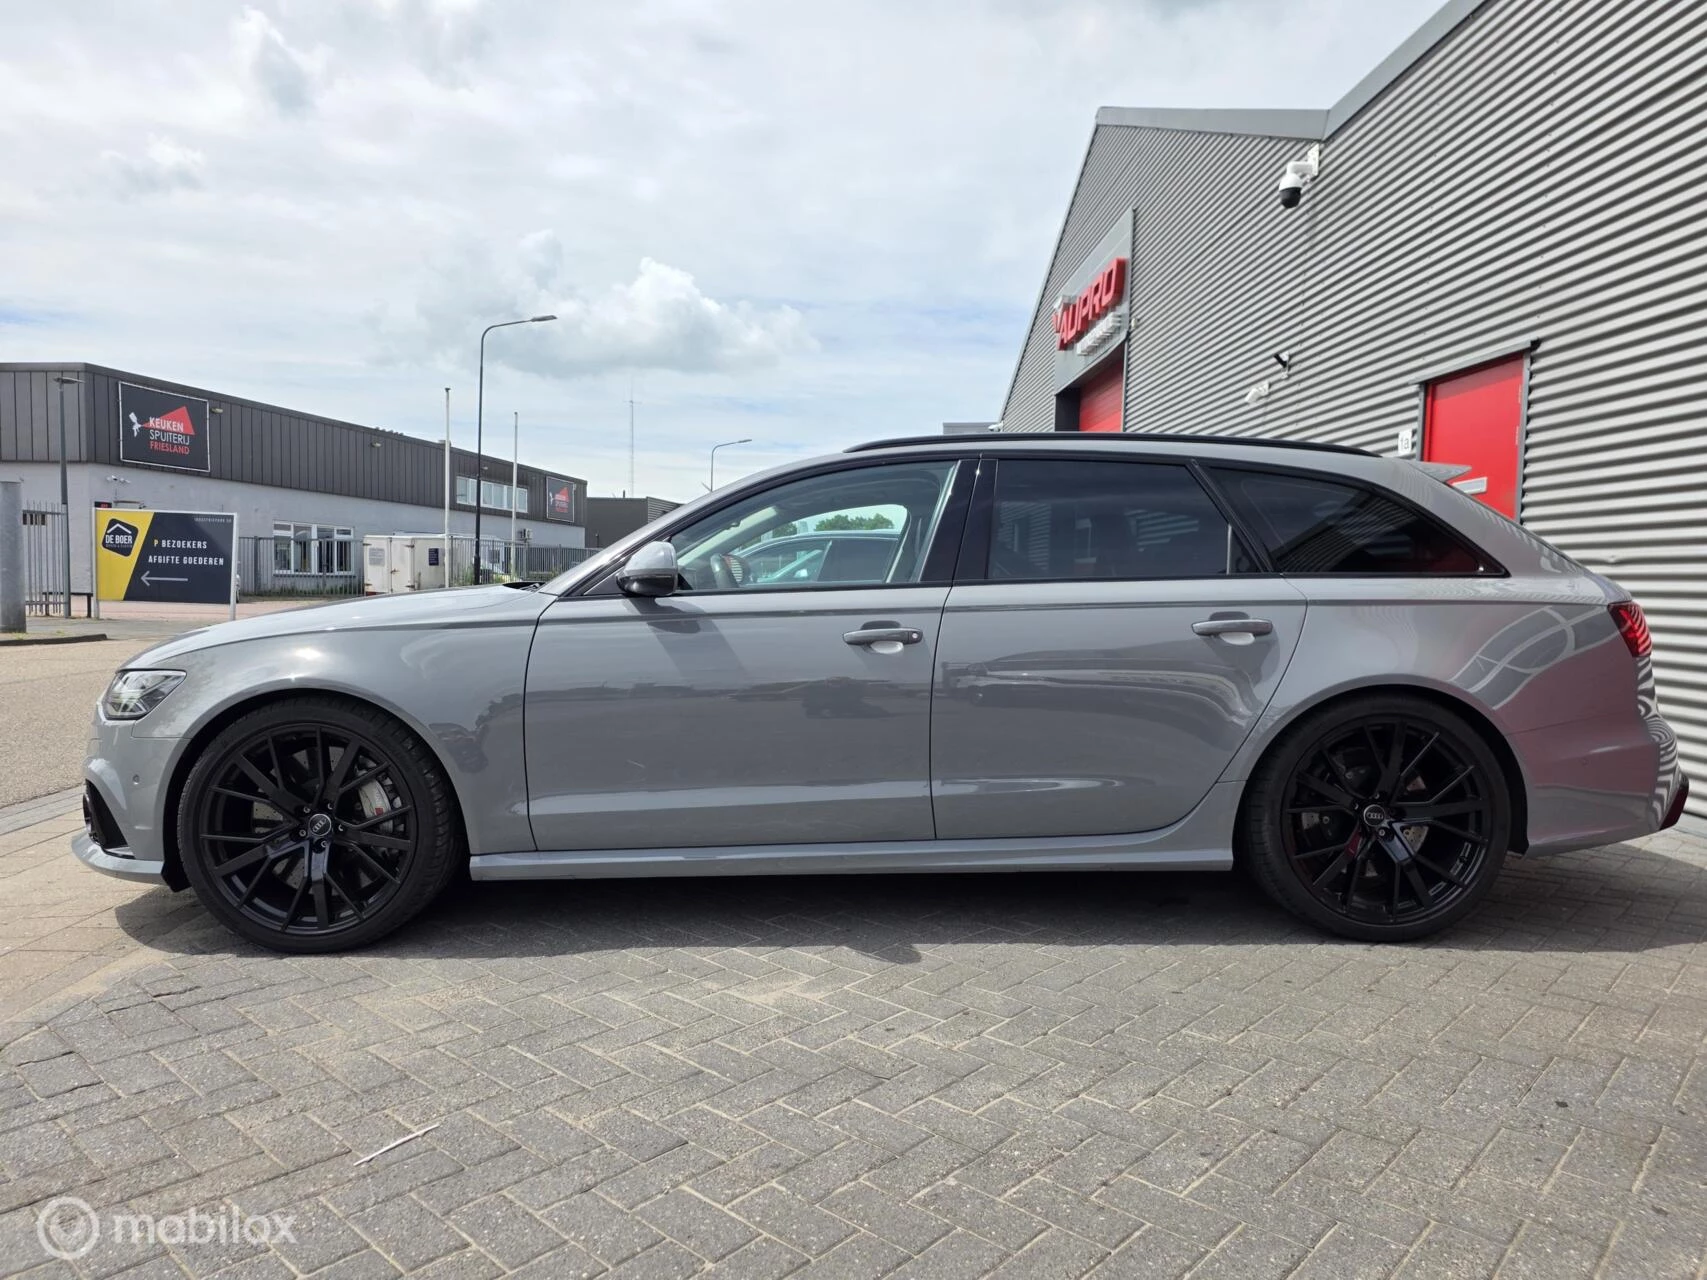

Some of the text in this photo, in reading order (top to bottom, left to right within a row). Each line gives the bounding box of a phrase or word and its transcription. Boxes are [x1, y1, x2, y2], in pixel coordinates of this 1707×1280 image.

[149, 416, 184, 433] KEUKEN
[149, 430, 190, 445] SPUITERIJ
[149, 441, 190, 455] FRIESLAND
[105, 534, 133, 544] DE BOER
[153, 539, 208, 549] P BEZOEKERS
[148, 555, 224, 566] AFGIFTE GOEDEREN
